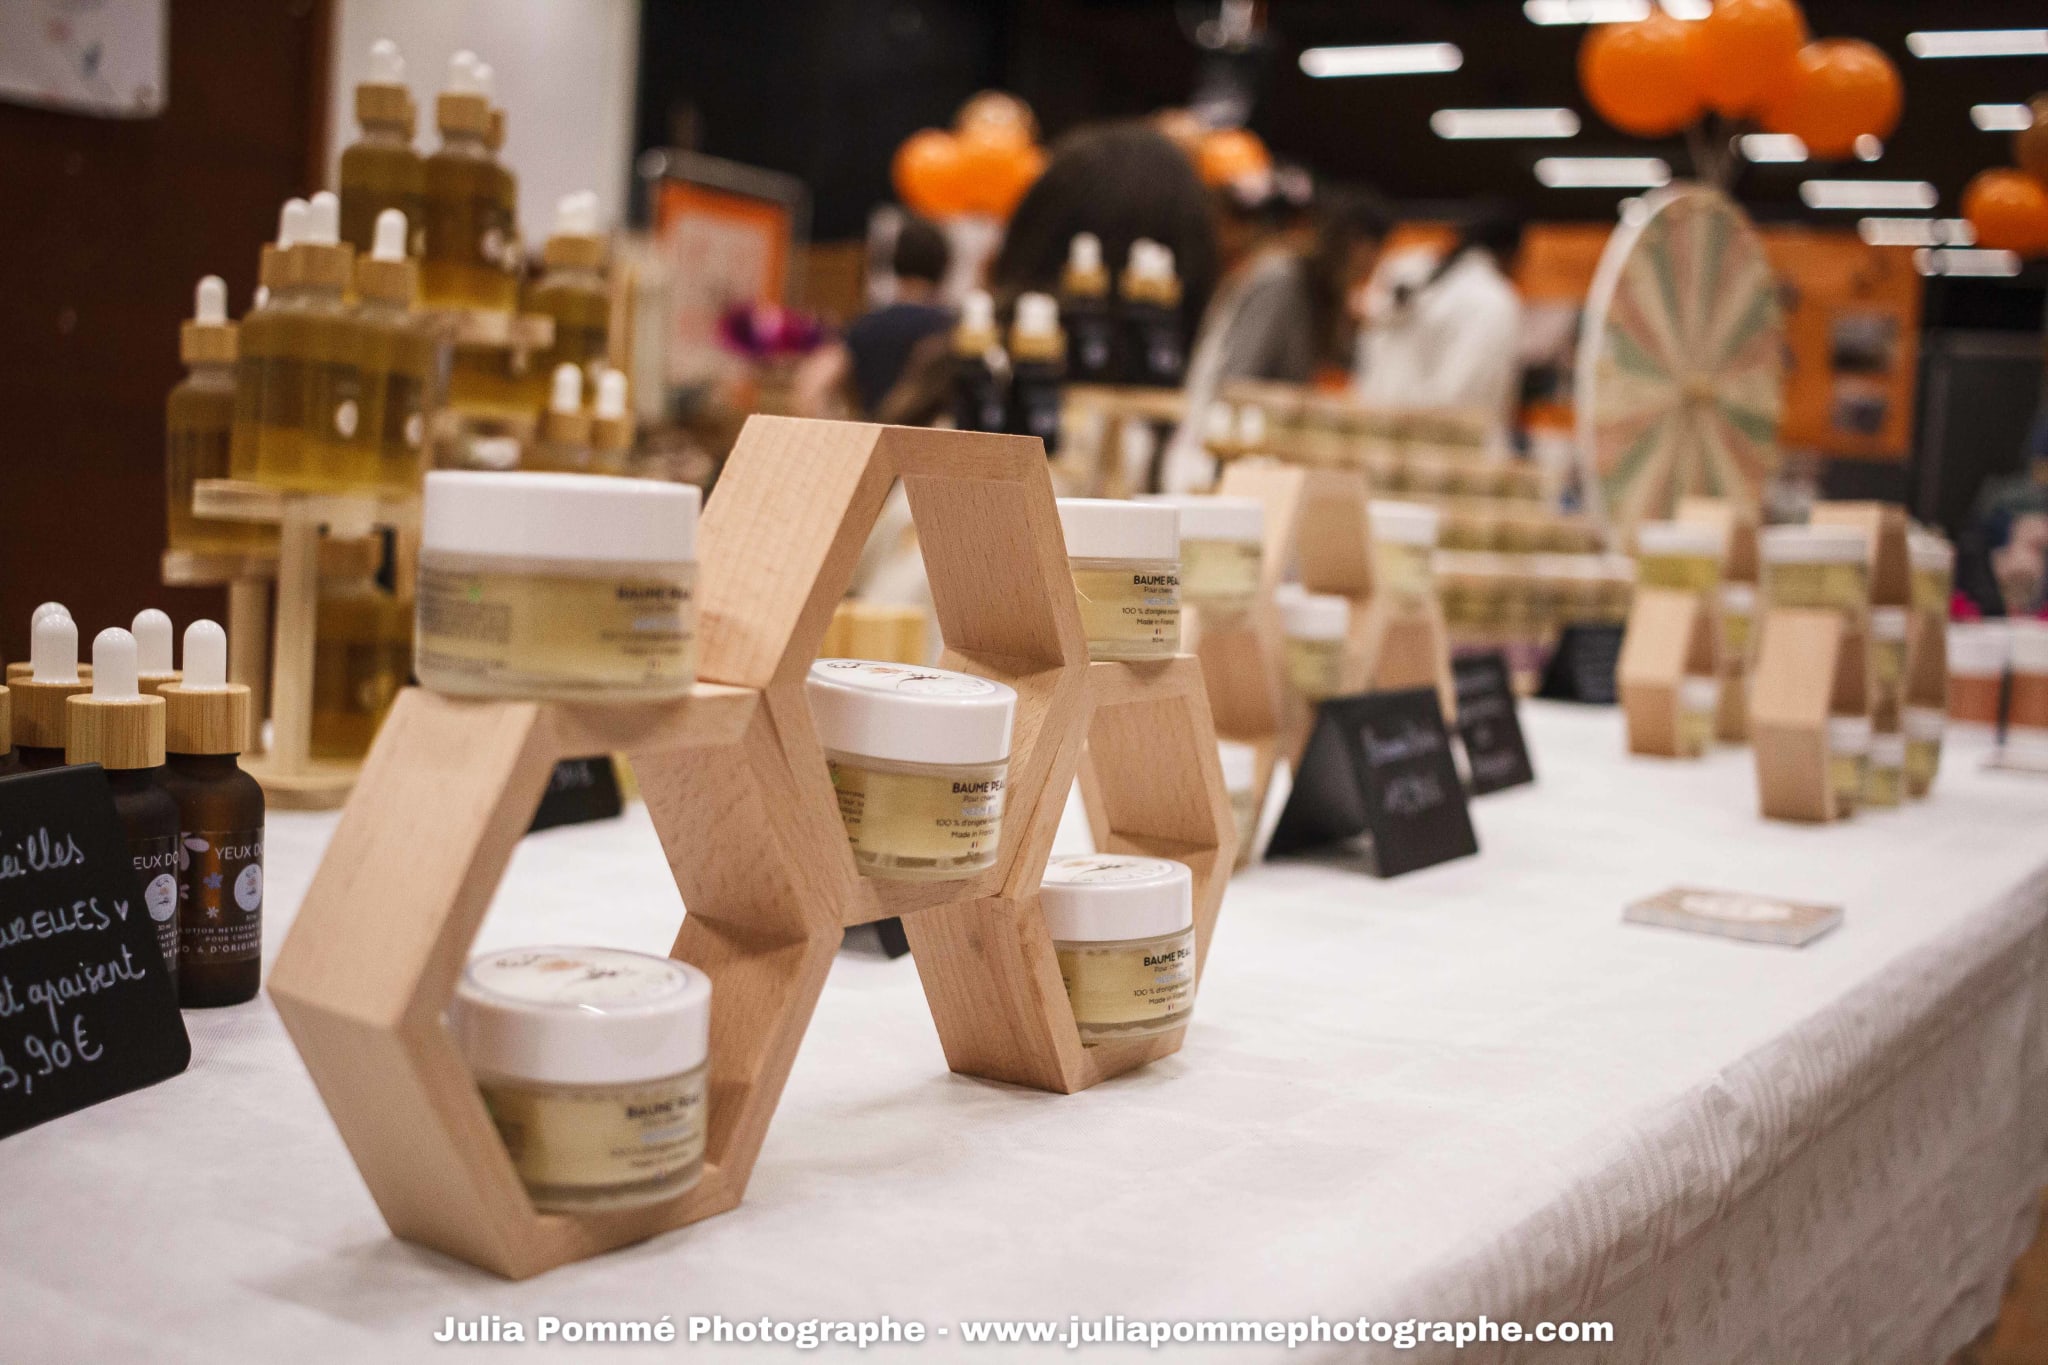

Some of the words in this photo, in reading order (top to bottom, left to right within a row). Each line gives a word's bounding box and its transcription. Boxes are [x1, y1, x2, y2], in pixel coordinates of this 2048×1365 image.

[1133, 575, 1166, 586] BAUME
[952, 781, 990, 794] BAUME
[0, 827, 85, 879] eilles
[133, 854, 162, 870] EUX
[165, 850, 180, 866] DO
[214, 844, 251, 860] YEUX
[0, 897, 111, 949] URELLES
[1143, 951, 1176, 967] BAUME
[27, 943, 146, 1035] apaisent
